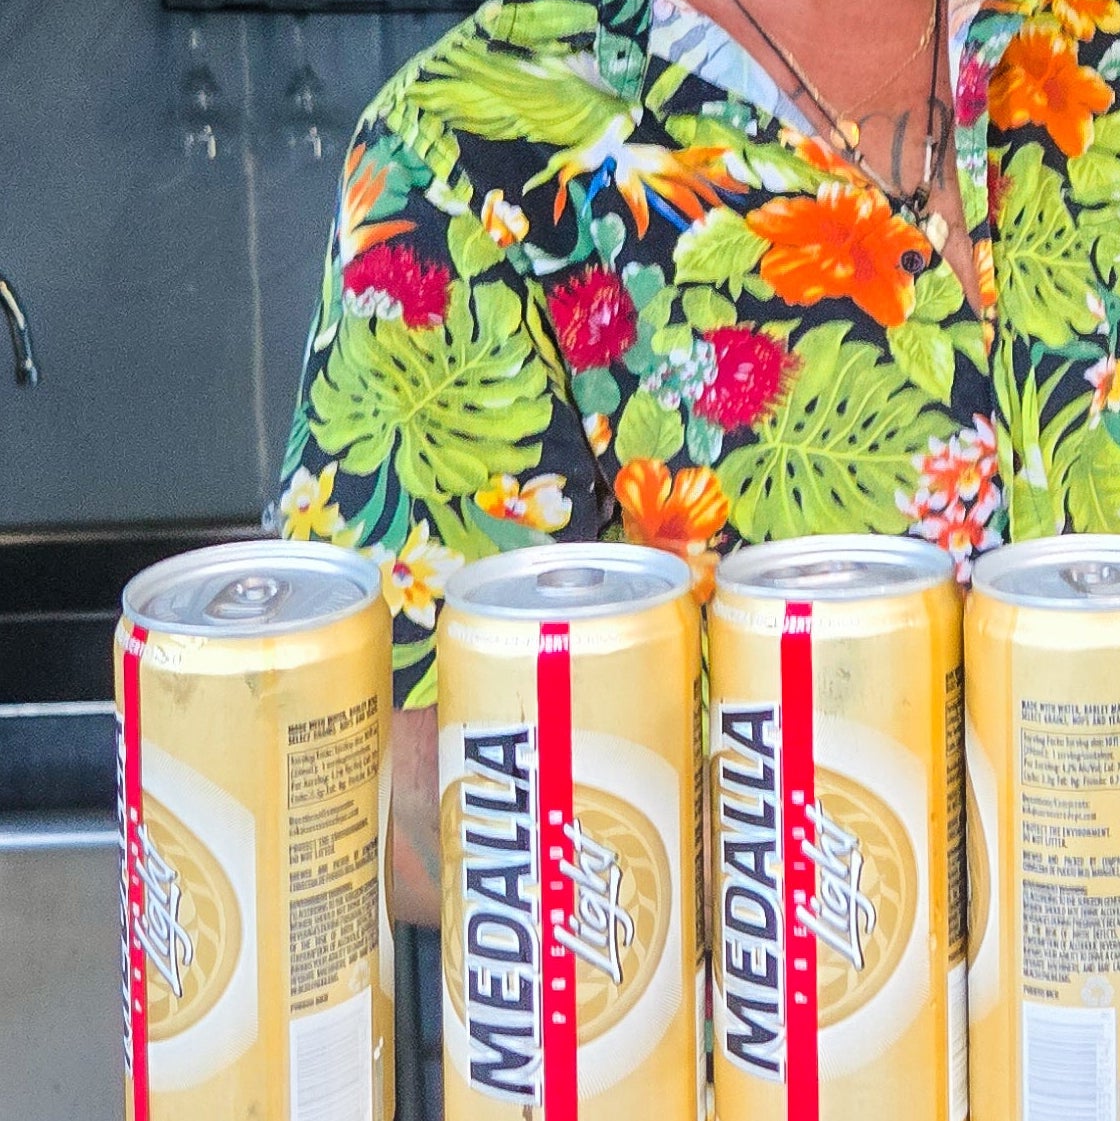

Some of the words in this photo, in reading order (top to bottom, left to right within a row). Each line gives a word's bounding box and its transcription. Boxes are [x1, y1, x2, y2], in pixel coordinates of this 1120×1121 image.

[137, 824, 195, 1000] Light
[459, 722, 543, 1109] MEDALLA
[554, 816, 634, 987] Light
[719, 701, 787, 1085] MEDALLA
[794, 798, 876, 973] Light
